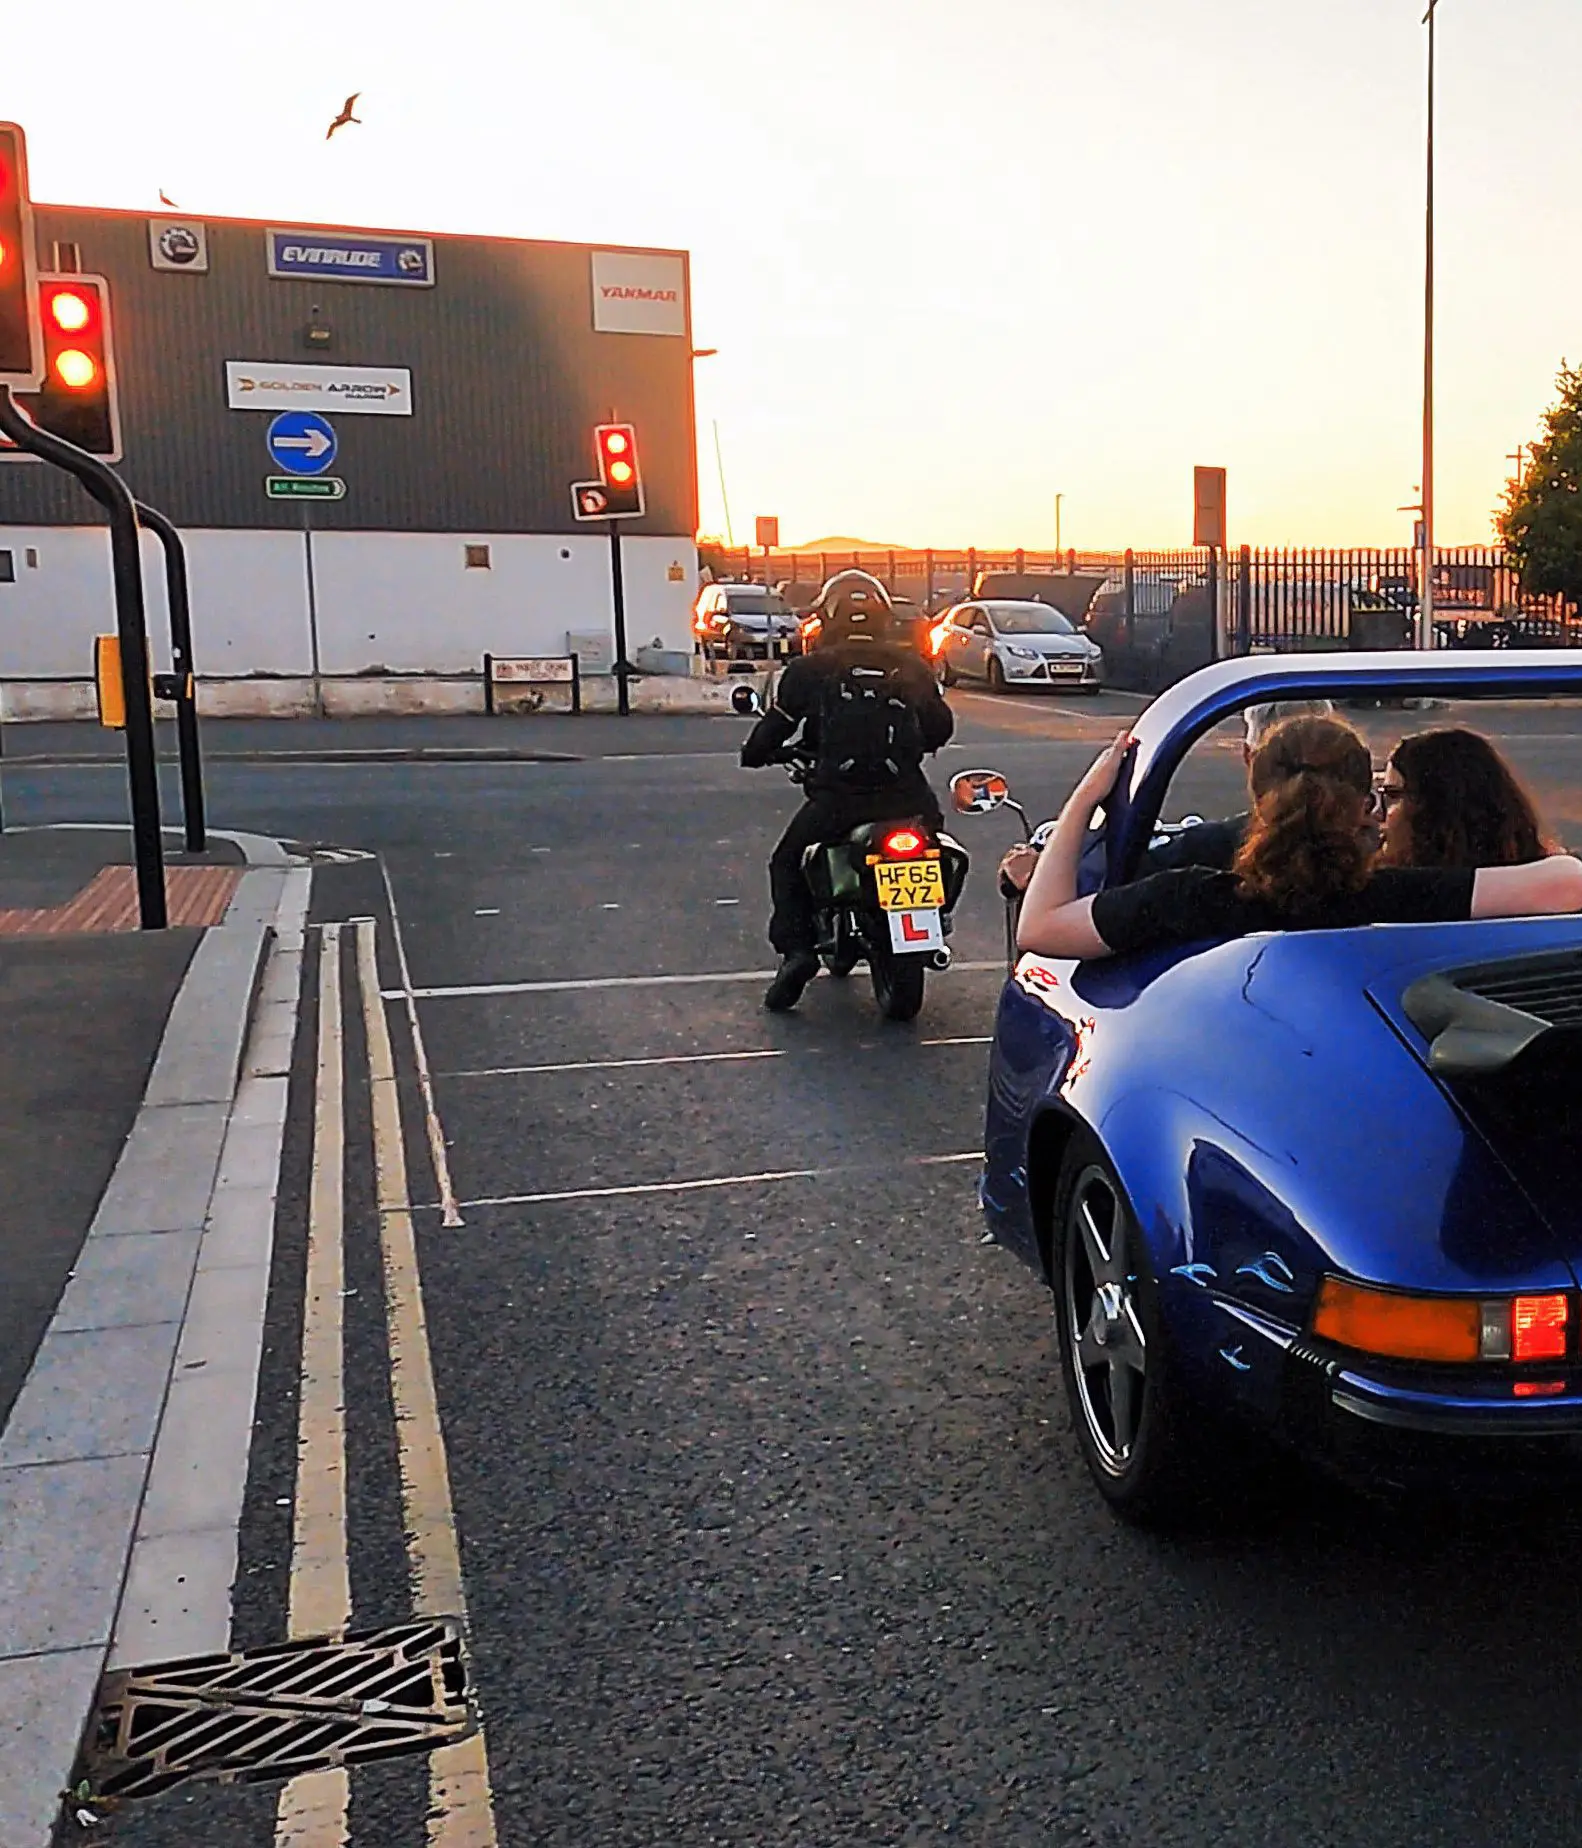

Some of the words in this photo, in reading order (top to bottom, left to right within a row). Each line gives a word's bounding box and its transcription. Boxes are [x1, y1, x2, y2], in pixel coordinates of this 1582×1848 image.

[282, 246, 382, 268] EVINRUDE
[600, 286, 677, 302] YANMAR
[259, 381, 322, 392] GOLDEN
[327, 383, 387, 394] ARROW
[878, 865, 939, 886] HF65
[889, 886, 935, 906] ZYZ
[901, 913, 930, 942] L
